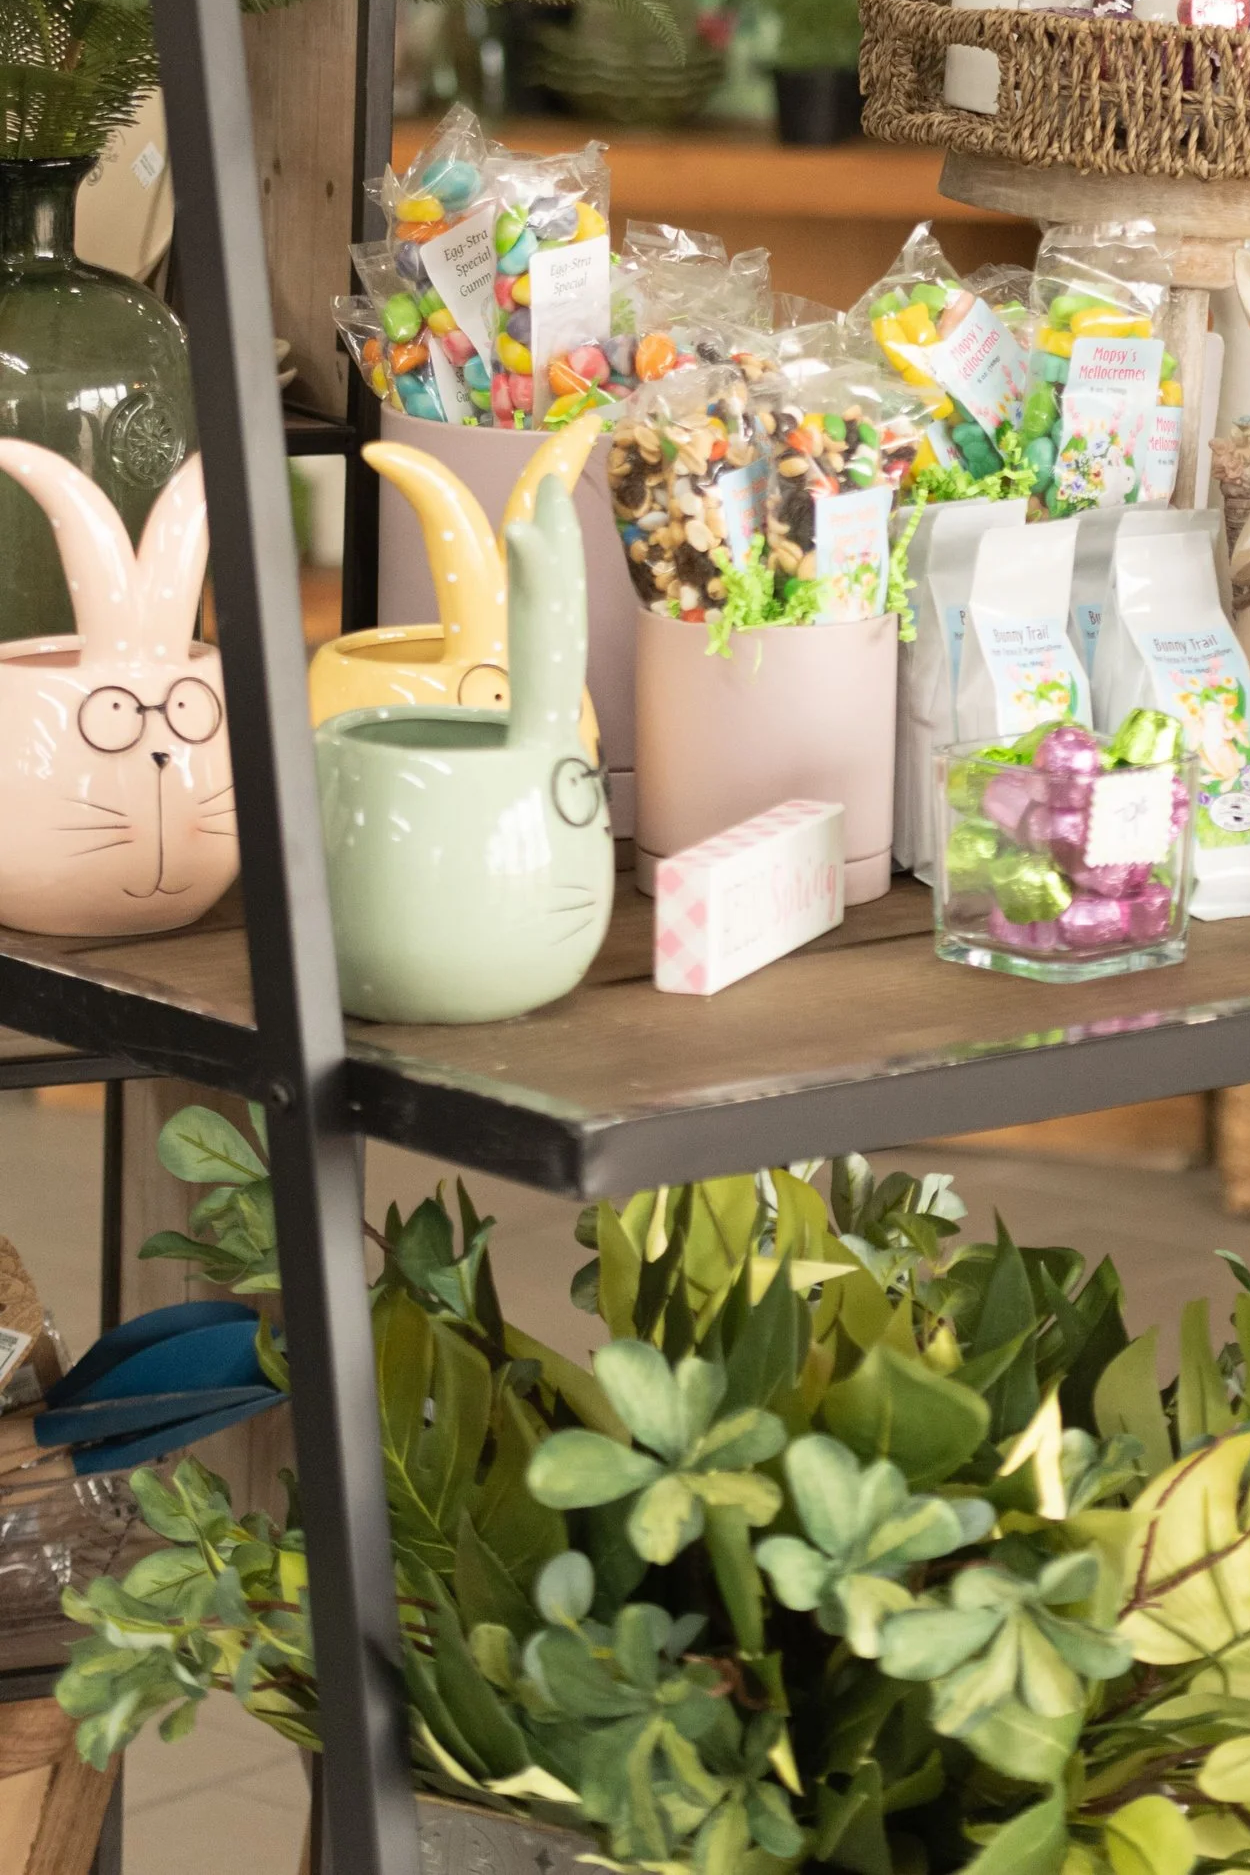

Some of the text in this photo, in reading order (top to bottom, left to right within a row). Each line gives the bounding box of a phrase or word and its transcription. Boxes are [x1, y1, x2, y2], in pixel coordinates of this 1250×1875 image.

[444, 229, 489, 262] Egg-Stra
[455, 246, 492, 277] Special
[550, 255, 593, 277] Egg-Stra
[553, 272, 588, 296] Special
[1079, 365, 1147, 381] Mellocremes
[1025, 624, 1049, 641] Trail
[1153, 634, 1218, 655] Bunny Trail
